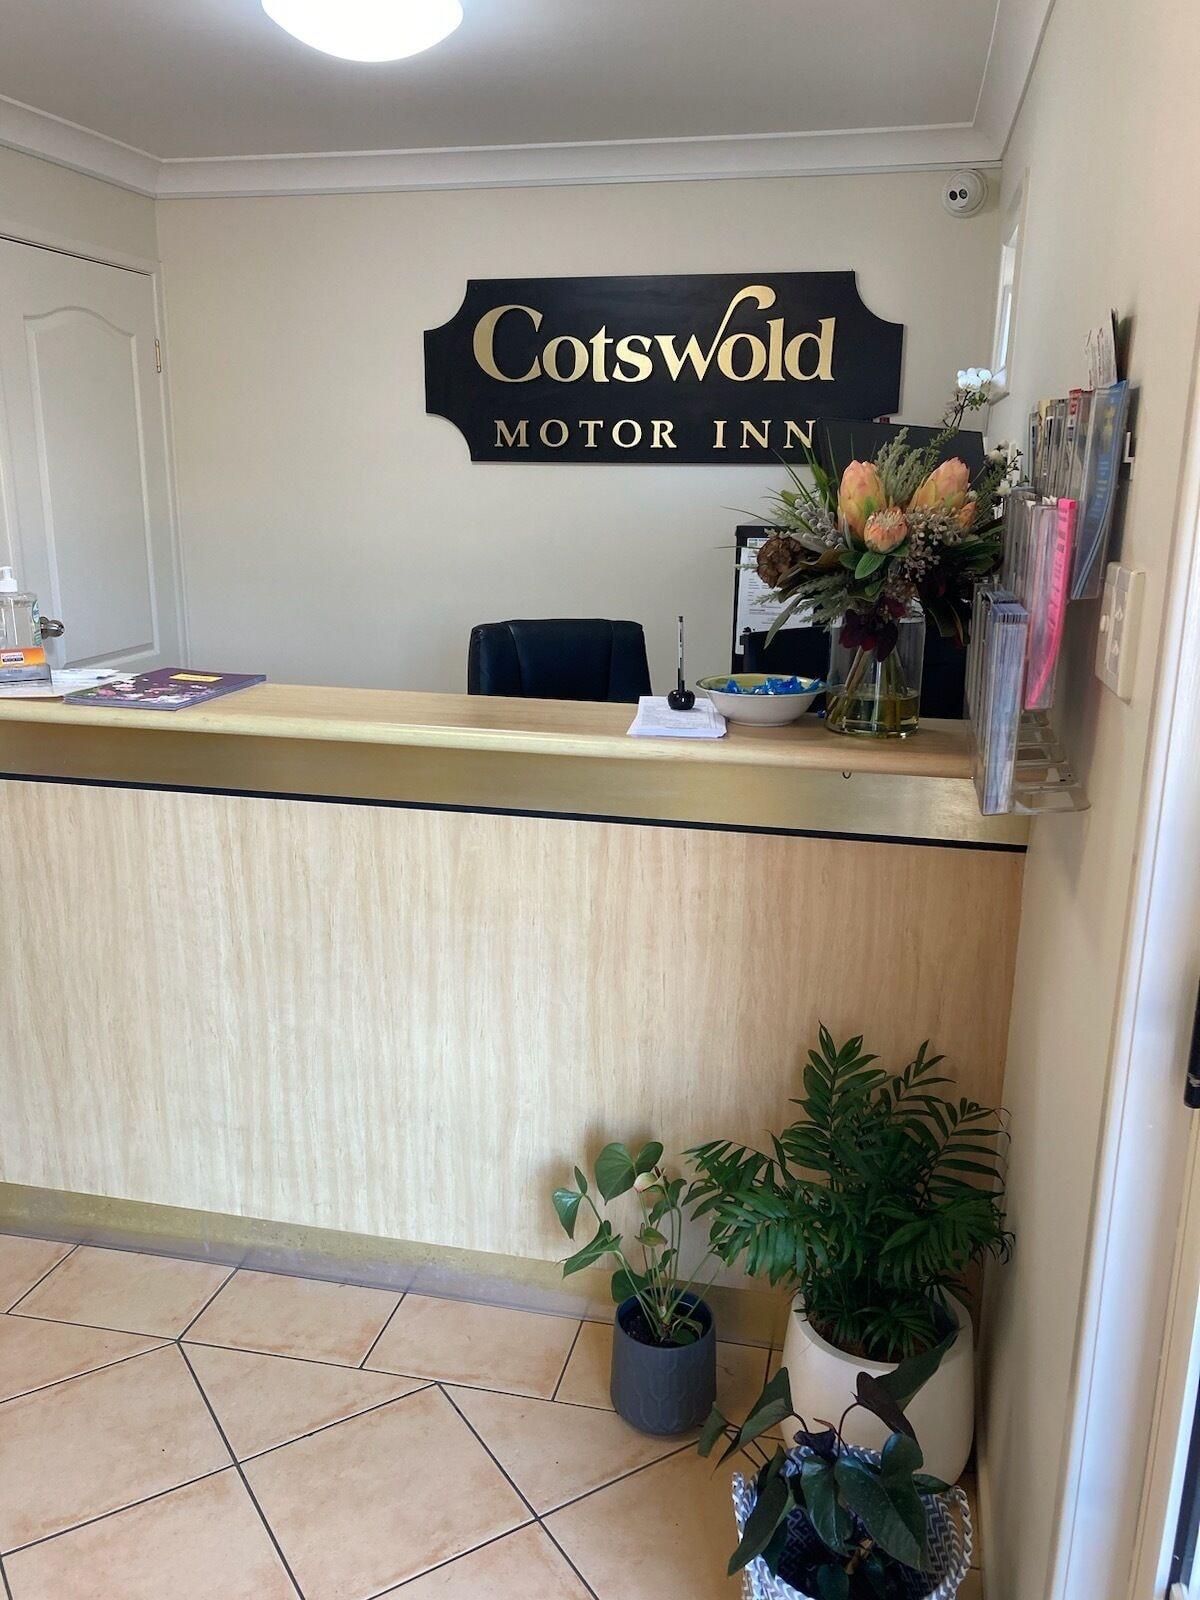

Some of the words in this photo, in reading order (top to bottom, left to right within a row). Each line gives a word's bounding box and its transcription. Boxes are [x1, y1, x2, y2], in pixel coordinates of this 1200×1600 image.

[472, 284, 836, 383] Cotswold
[494, 419, 677, 449] MOTOR
[713, 418, 816, 449] INN
